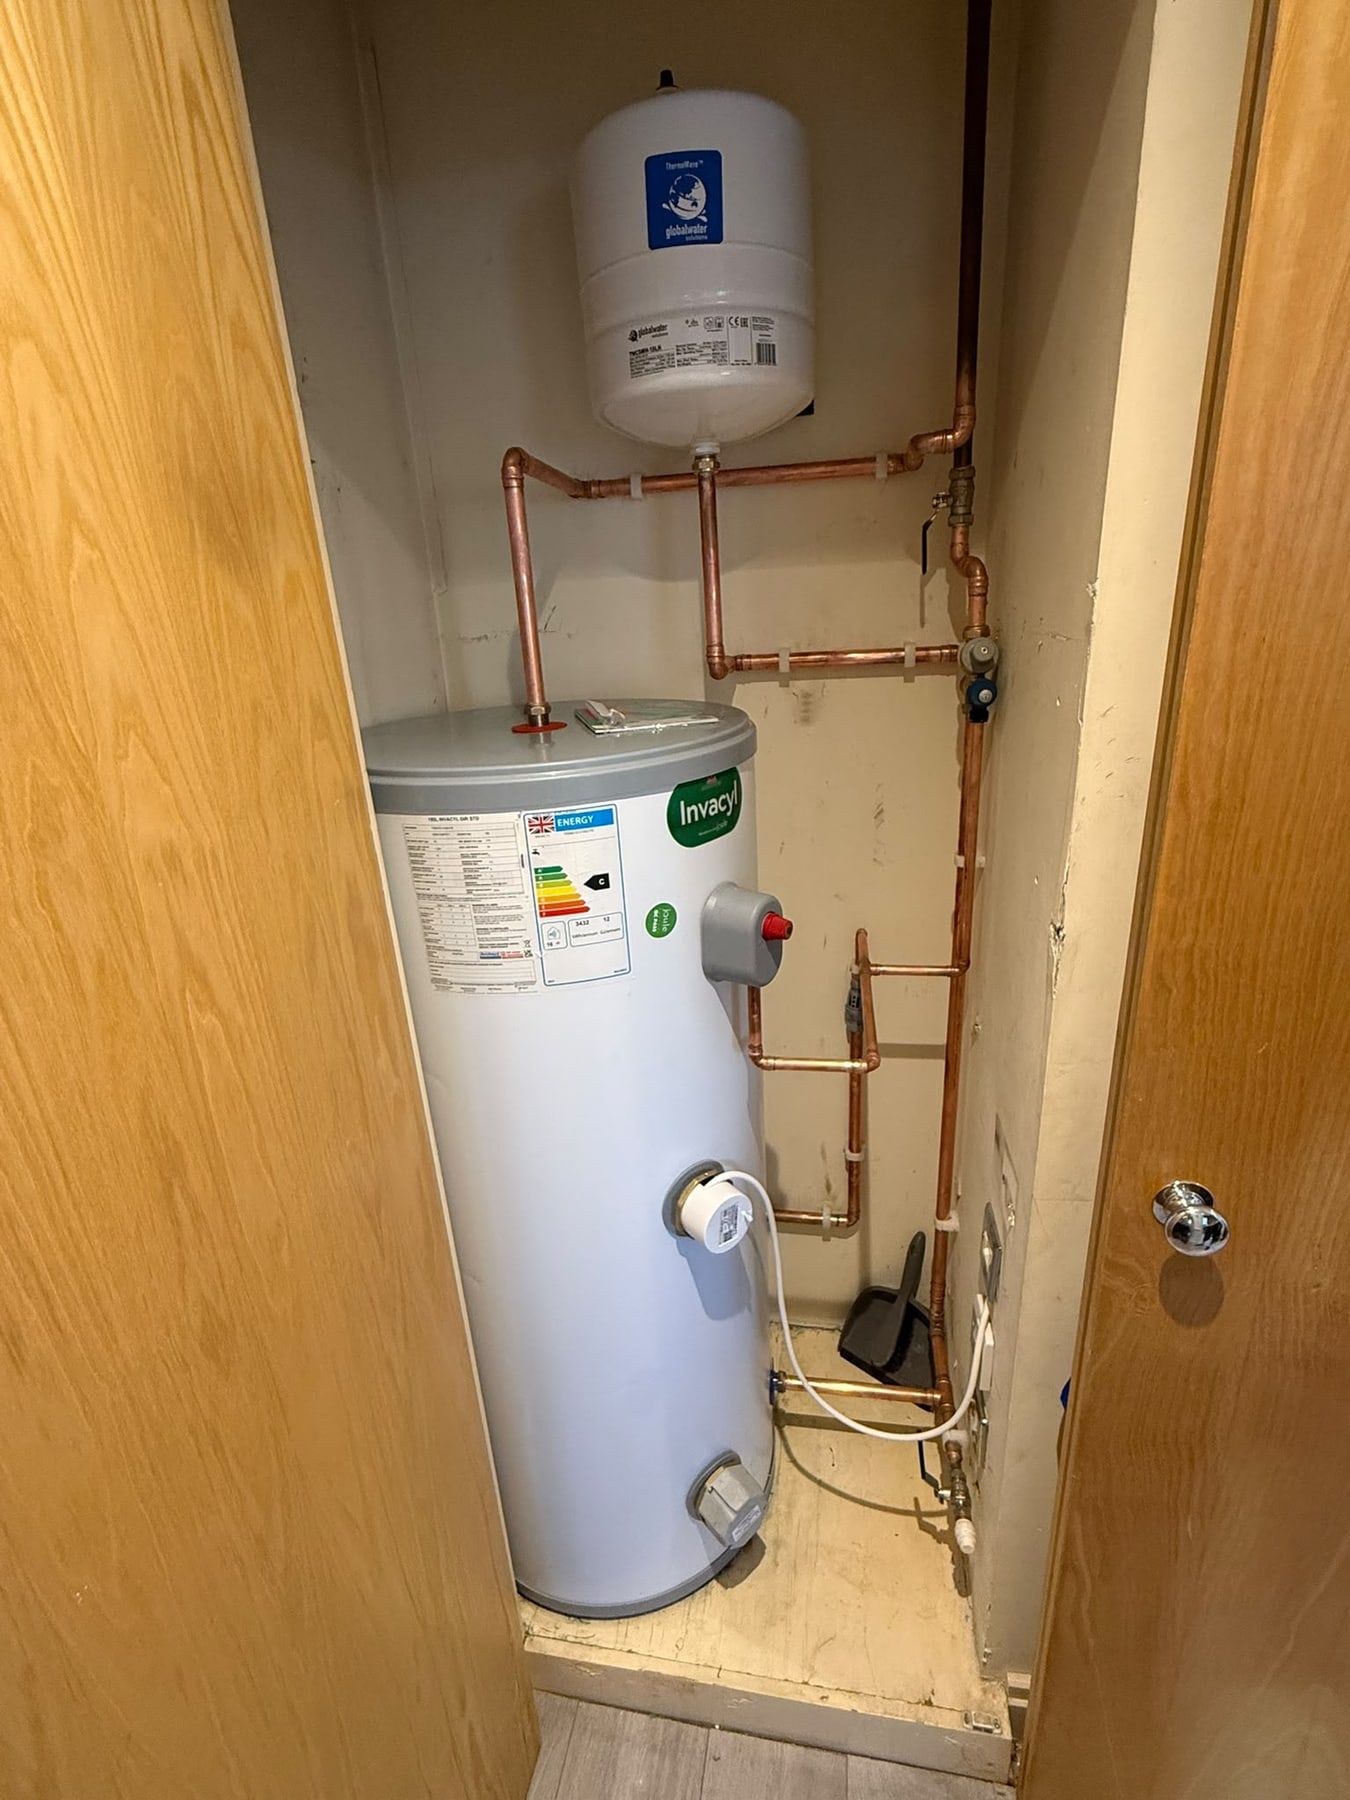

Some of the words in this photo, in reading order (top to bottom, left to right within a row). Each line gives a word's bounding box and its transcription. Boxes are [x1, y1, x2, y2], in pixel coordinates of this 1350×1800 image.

[680, 780, 738, 826] Invacyl
[557, 815, 594, 827] ENERGY
[598, 878, 606, 886] C
